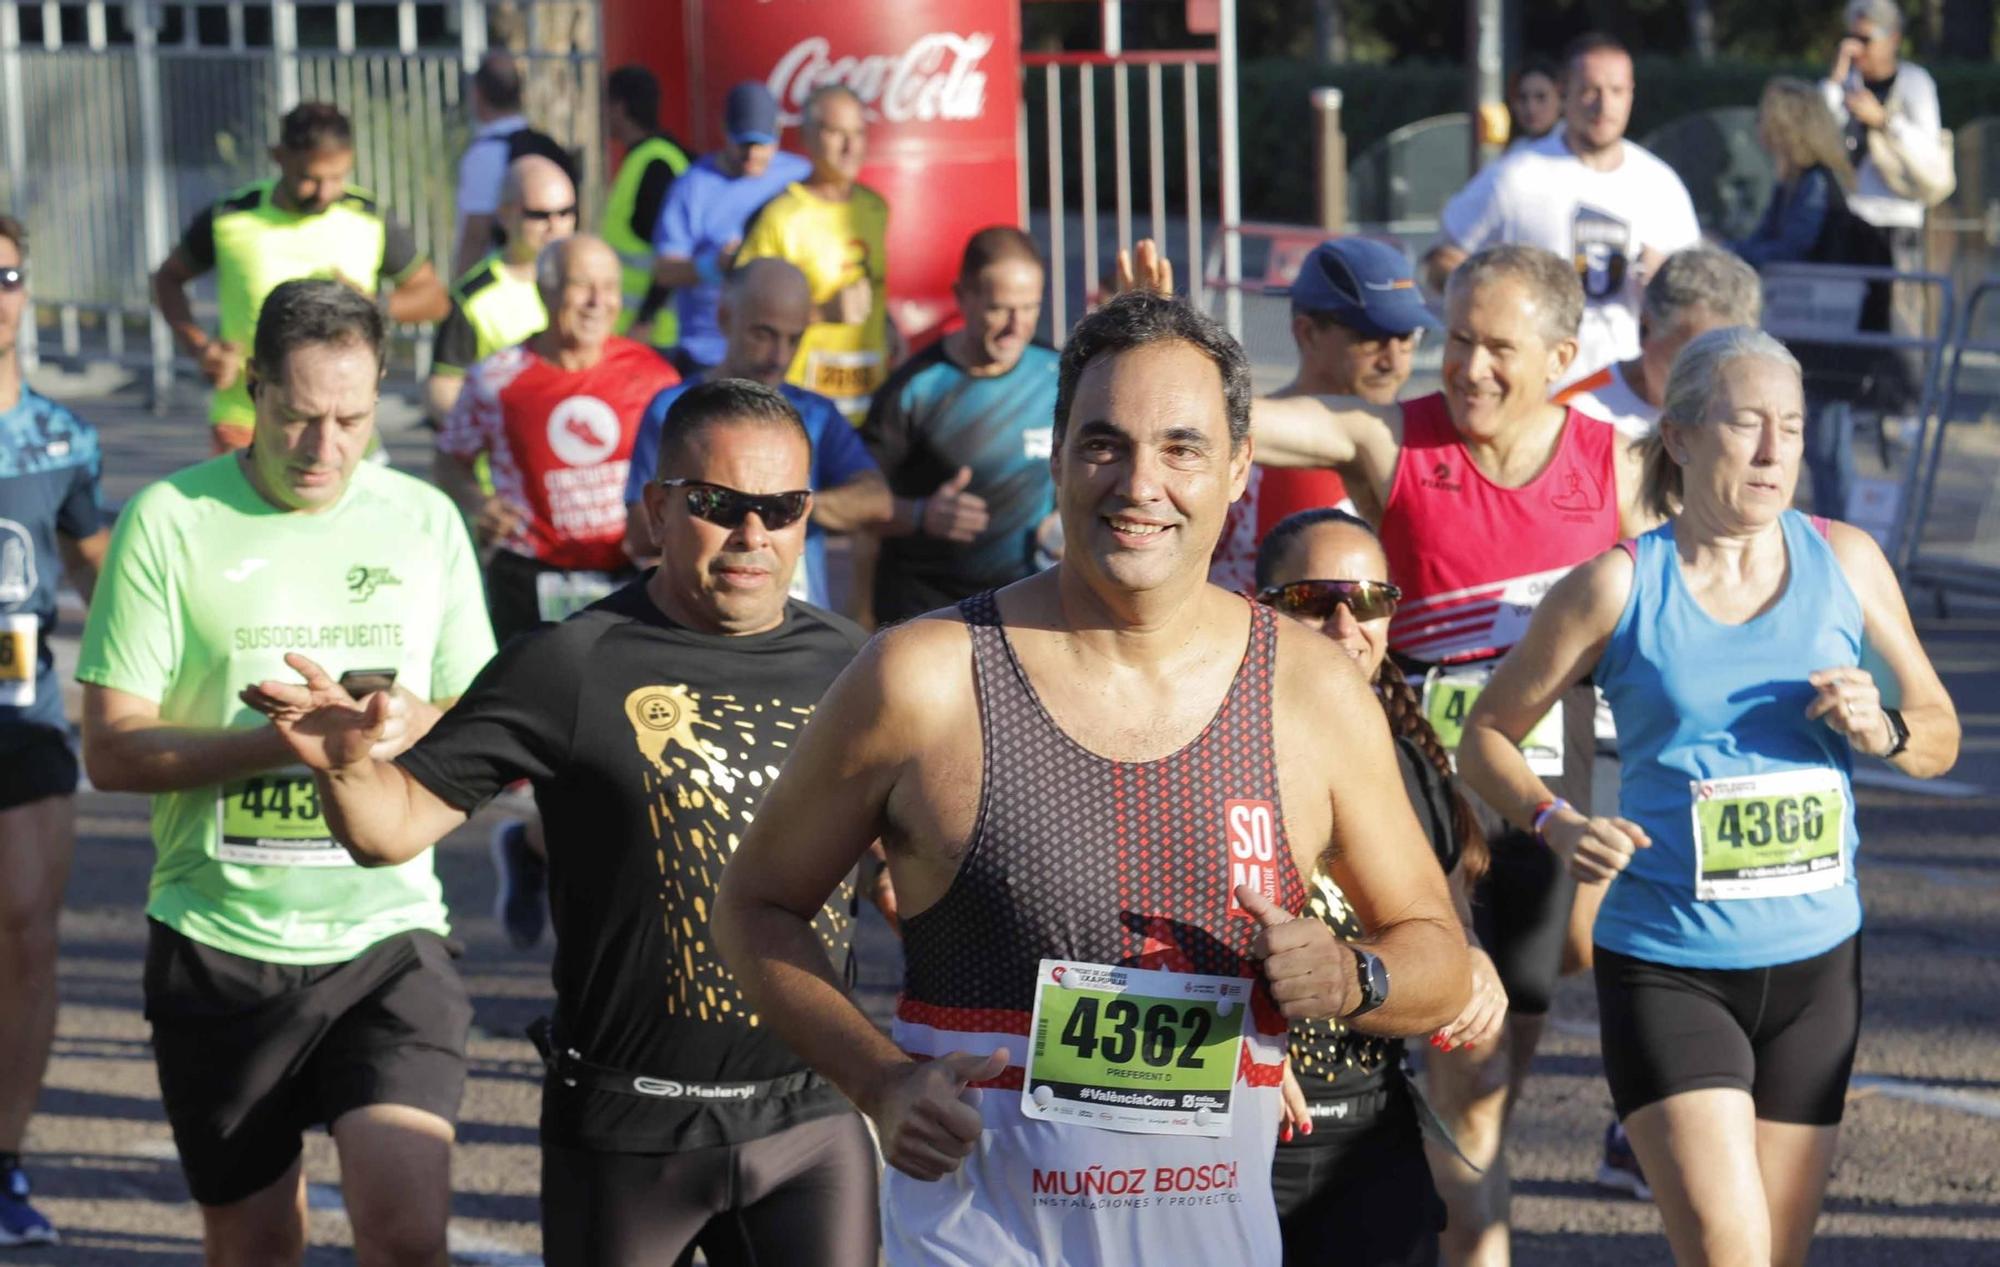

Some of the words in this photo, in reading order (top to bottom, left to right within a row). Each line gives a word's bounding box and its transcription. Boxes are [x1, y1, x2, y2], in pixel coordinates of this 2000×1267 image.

[235, 624, 404, 651] SUSODELAFUENTE
[240, 777, 321, 821] 443
[1061, 996, 1212, 1069] 4362
[1106, 1067, 1165, 1081] PREFERENT
[1166, 1073, 1172, 1082] D
[685, 1085, 755, 1099] Kalenji
[1080, 1087, 1176, 1108] #ValènciaCorre
[1306, 1102, 1348, 1119] alenji
[1033, 1165, 1147, 1196] MUÑOZ
[1154, 1161, 1238, 1192] BOSCH
[1033, 1197, 1149, 1210] INSTALACIONES
[1156, 1198, 1162, 1206] Y
